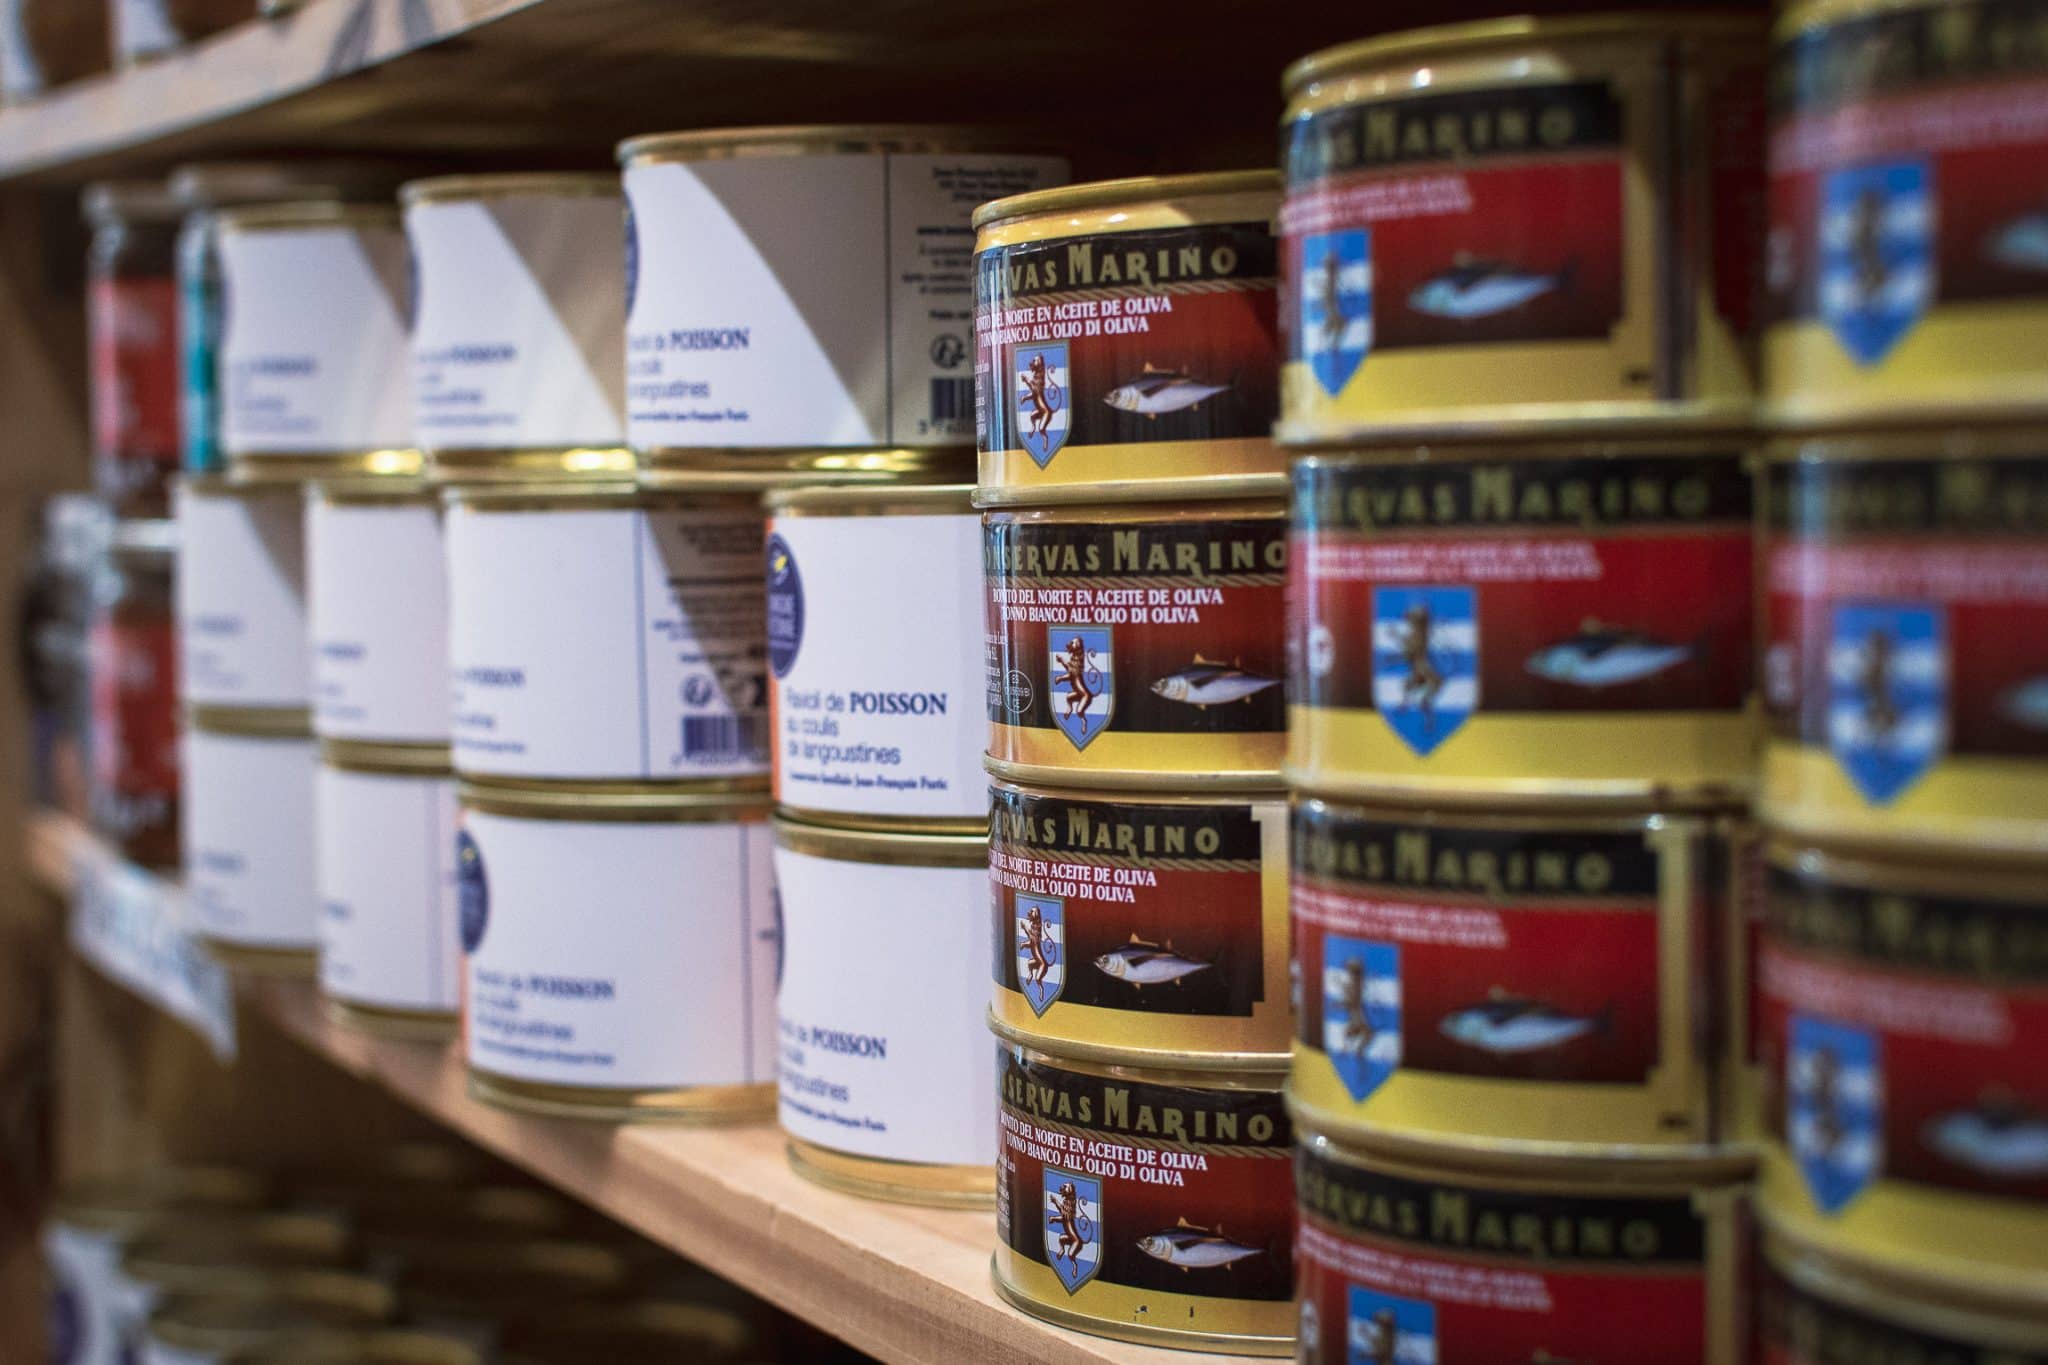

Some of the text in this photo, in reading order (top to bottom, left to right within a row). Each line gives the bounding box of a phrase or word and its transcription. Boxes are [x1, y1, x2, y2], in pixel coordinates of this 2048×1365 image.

[1068, 243, 1237, 289] MARINO
[1006, 308, 1035, 325] NORTE
[1037, 306, 1051, 319] EN
[1054, 300, 1098, 320] ACEITE
[1101, 298, 1121, 317] DE
[1125, 296, 1172, 315] OLIVA
[671, 328, 750, 351] POISSON
[1032, 319, 1082, 340] ALL'OLIO
[1085, 319, 1100, 335] DI
[1103, 316, 1149, 334] OLIVA
[1112, 529, 1287, 580] MARINO
[1019, 589, 1036, 604] DEL
[1038, 589, 1073, 605] NORTE
[1076, 590, 1092, 605] EN
[1095, 589, 1147, 606] ACEITE
[1149, 589, 1170, 605] DE
[1174, 587, 1224, 605] OLIVA
[1029, 606, 1067, 622] BIANCO
[1070, 606, 1127, 623] ALL'OLIO
[1130, 607, 1147, 624] DI
[1151, 606, 1199, 623] OLIVA
[850, 691, 947, 714] POISSON
[1067, 807, 1221, 865] MARINO
[1009, 856, 1032, 874] NORTE
[1034, 861, 1048, 876] EN
[1050, 864, 1092, 881] ACEITE
[1094, 866, 1111, 882] DE
[1114, 869, 1157, 886] OLIVA
[1004, 872, 1028, 890] BIANCO
[1030, 878, 1077, 897] ALL'OLIO
[1079, 882, 1093, 899] DI
[1096, 886, 1135, 903] OLIVA
[812, 1027, 886, 1058] POISSON
[1104, 1086, 1274, 1147] MARINO
[1007, 1131, 1185, 1186] TONNO BIANCO ALL'OLIO DI OLIVA
[1020, 1122, 1033, 1140] DEL
[1035, 1127, 1066, 1150] NORTE
[1069, 1137, 1084, 1153] EN
[1087, 1141, 1132, 1162] ACEITE
[1136, 1148, 1157, 1165] DE
[1160, 1151, 1208, 1171] OLIVA
